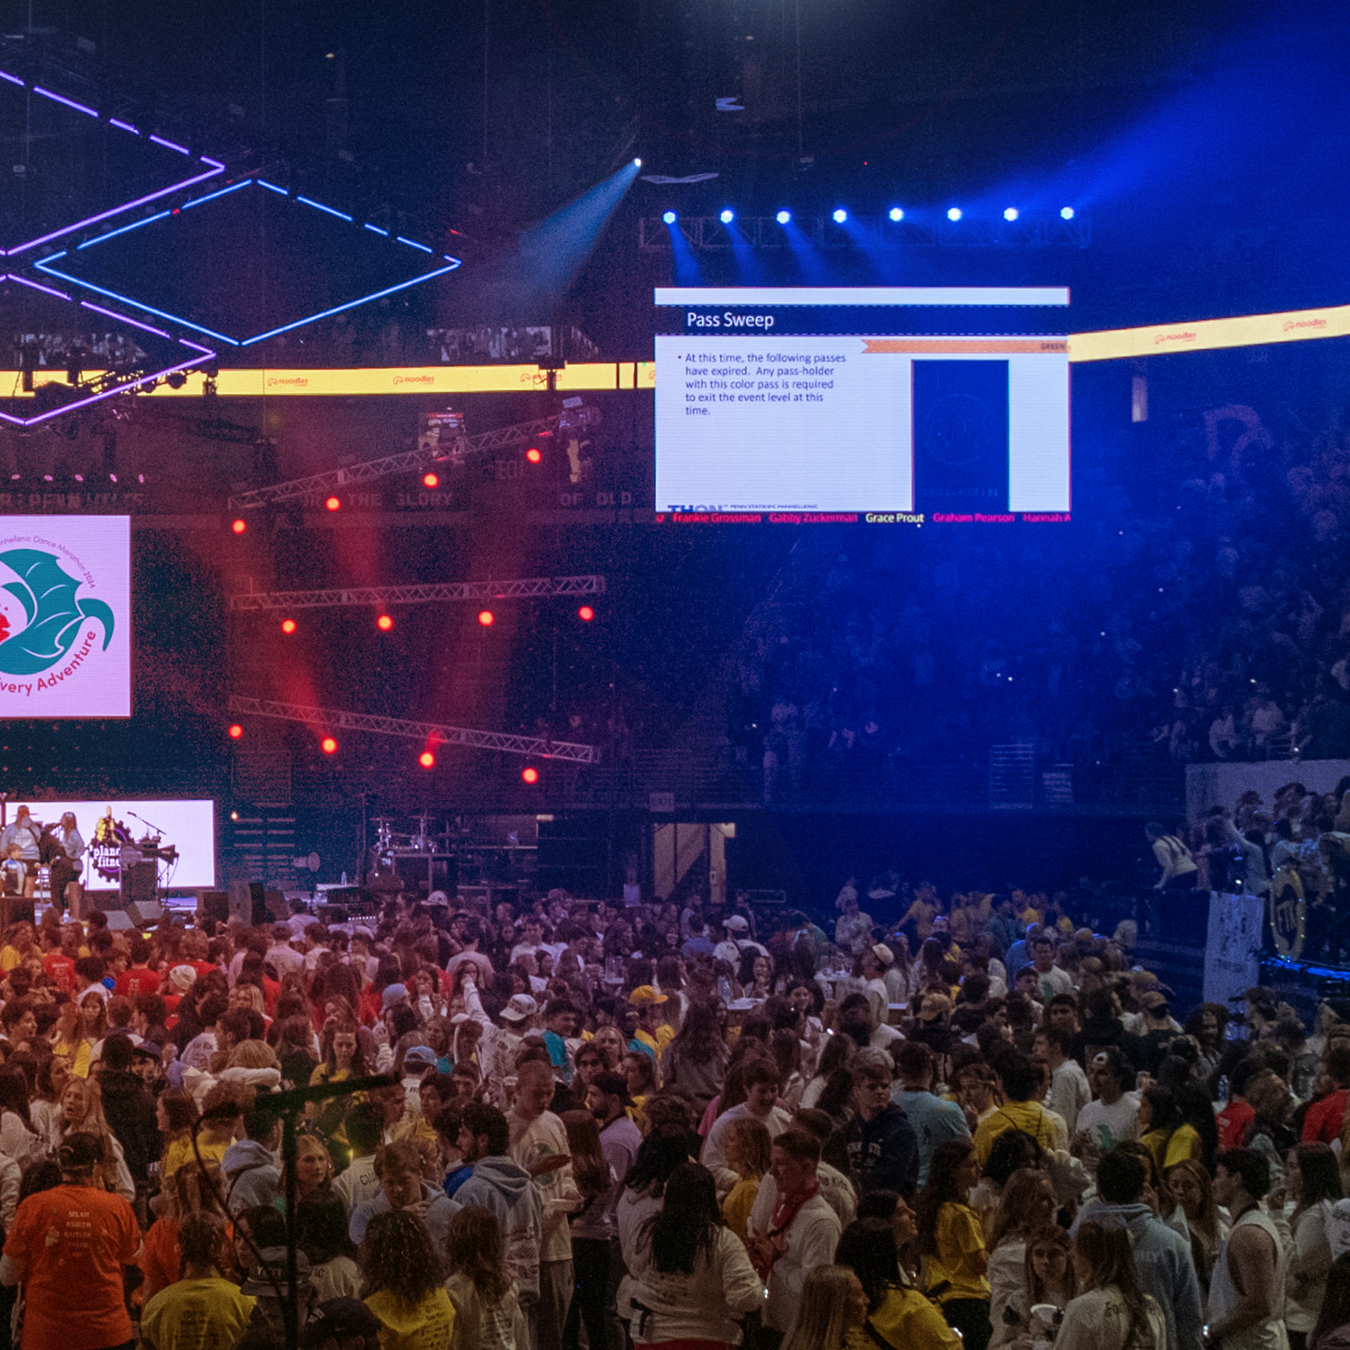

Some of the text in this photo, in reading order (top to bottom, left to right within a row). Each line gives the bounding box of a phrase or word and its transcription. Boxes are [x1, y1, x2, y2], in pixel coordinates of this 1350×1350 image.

[687, 312, 774, 331] Pass Sweep
[685, 353, 846, 366] At this time, the following passes
[685, 366, 834, 378] have expired. Any pass-holder
[685, 379, 834, 392] with this color pass is required
[685, 392, 824, 402] to exit the event level at this
[685, 406, 711, 416] time.
[672, 513, 709, 523] Frankie
[711, 513, 761, 523] Grossman
[769, 513, 801, 524] Gabby
[866, 513, 894, 523] Grace
[896, 513, 924, 523] Prout
[933, 513, 972, 522] Graham
[975, 513, 1015, 522] Pearson
[1023, 513, 1062, 522] Hannah
[83, 570, 96, 589] 2024
[37, 631, 96, 690] Adventure
[93, 845, 121, 859] plane
[98, 856, 121, 867] fitne
